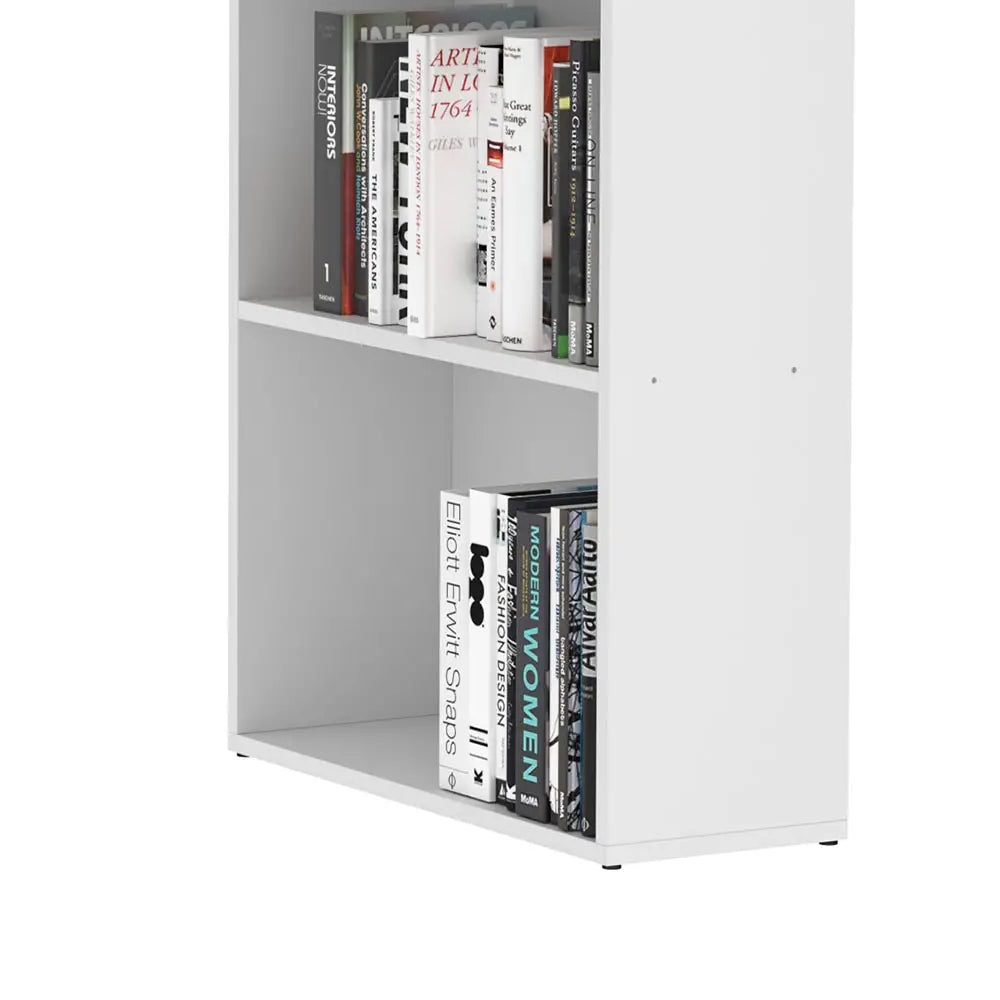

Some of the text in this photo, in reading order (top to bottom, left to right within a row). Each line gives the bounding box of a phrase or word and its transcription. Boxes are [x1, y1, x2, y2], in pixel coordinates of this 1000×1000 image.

[317, 64, 327, 116] NOW!
[430, 73, 456, 92] IN
[430, 99, 473, 119] 1764
[509, 99, 532, 111] Great
[571, 60, 580, 113] Picasso
[326, 64, 337, 160] INTERIORS
[428, 136, 464, 151] GILES
[571, 115, 580, 171] Guitars
[360, 82, 368, 269] Conversations with Architects
[490, 177, 497, 193] An
[324, 263, 329, 283] 1
[528, 525, 540, 621] MODERN
[581, 539, 597, 605] Aalto
[443, 500, 462, 756] Elliott Erwitt Snaps
[497, 574, 505, 654] FASHION
[581, 606, 597, 672] Alvar
[496, 660, 505, 728] DESIGN
[522, 627, 539, 784] WOMEN
[520, 793, 539, 808] MoMA
